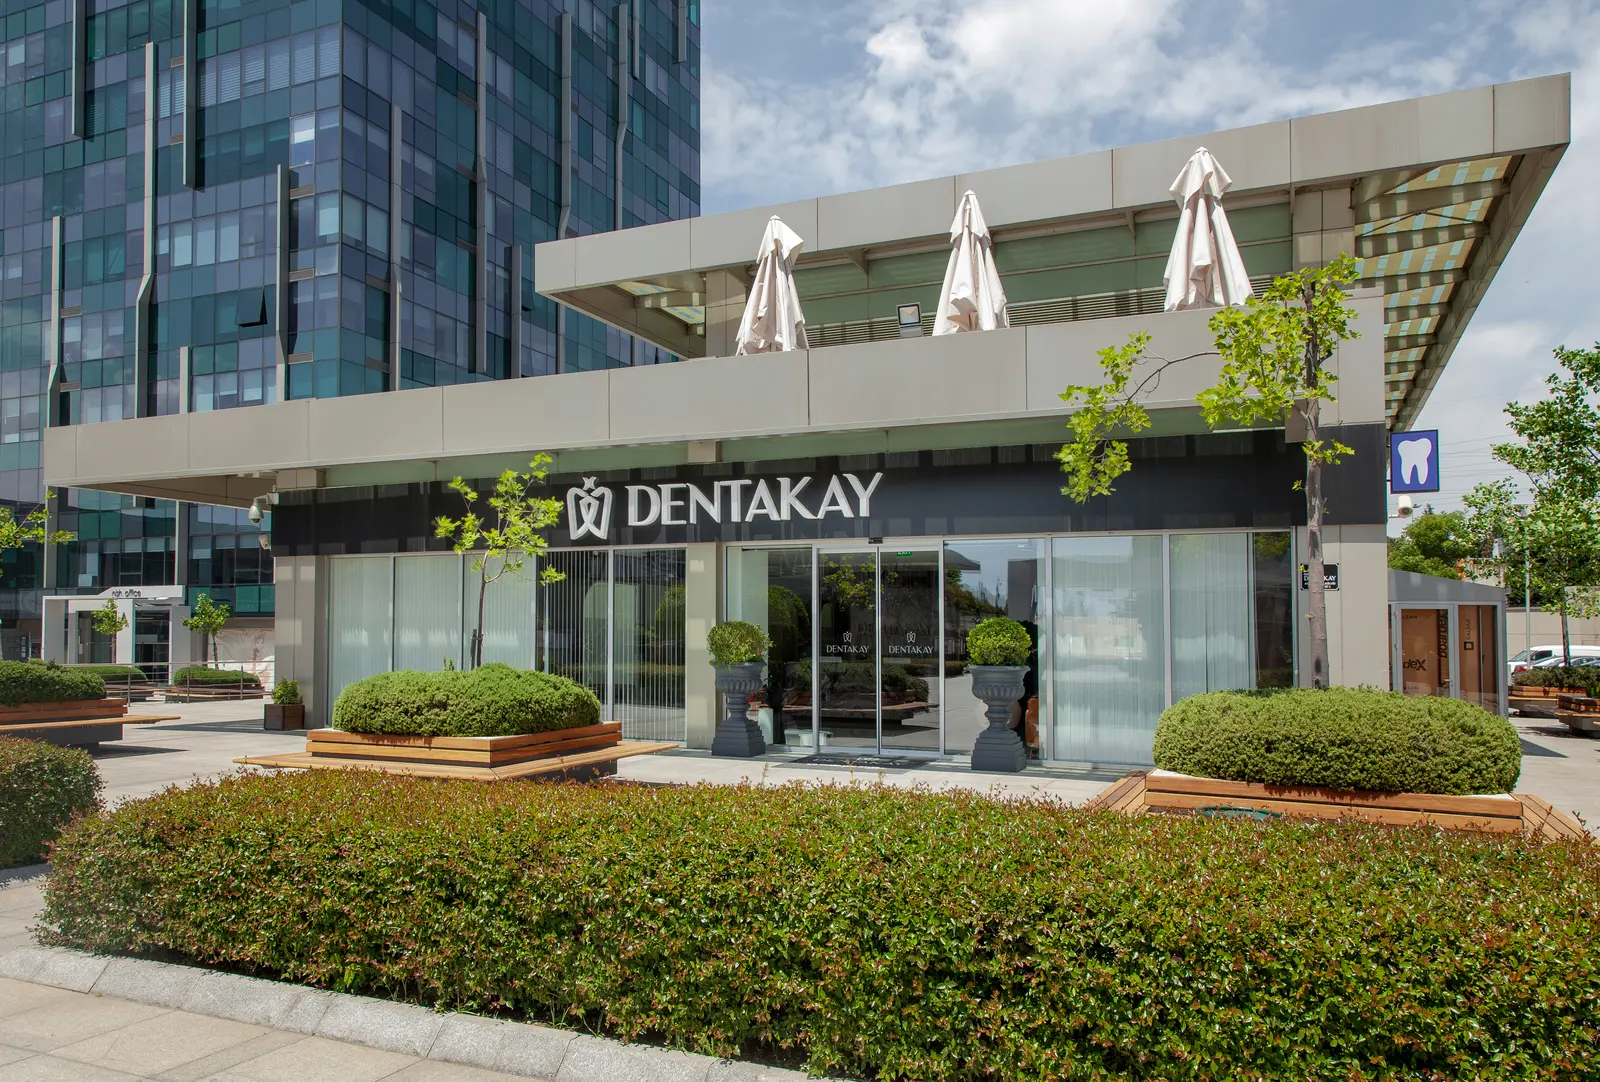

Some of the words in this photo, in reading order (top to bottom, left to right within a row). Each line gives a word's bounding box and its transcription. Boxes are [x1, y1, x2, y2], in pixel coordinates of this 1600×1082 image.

[624, 472, 884, 527] DENTAKAY
[826, 645, 870, 654] DENTAKAY
[888, 645, 934, 654] DENTAKAY
